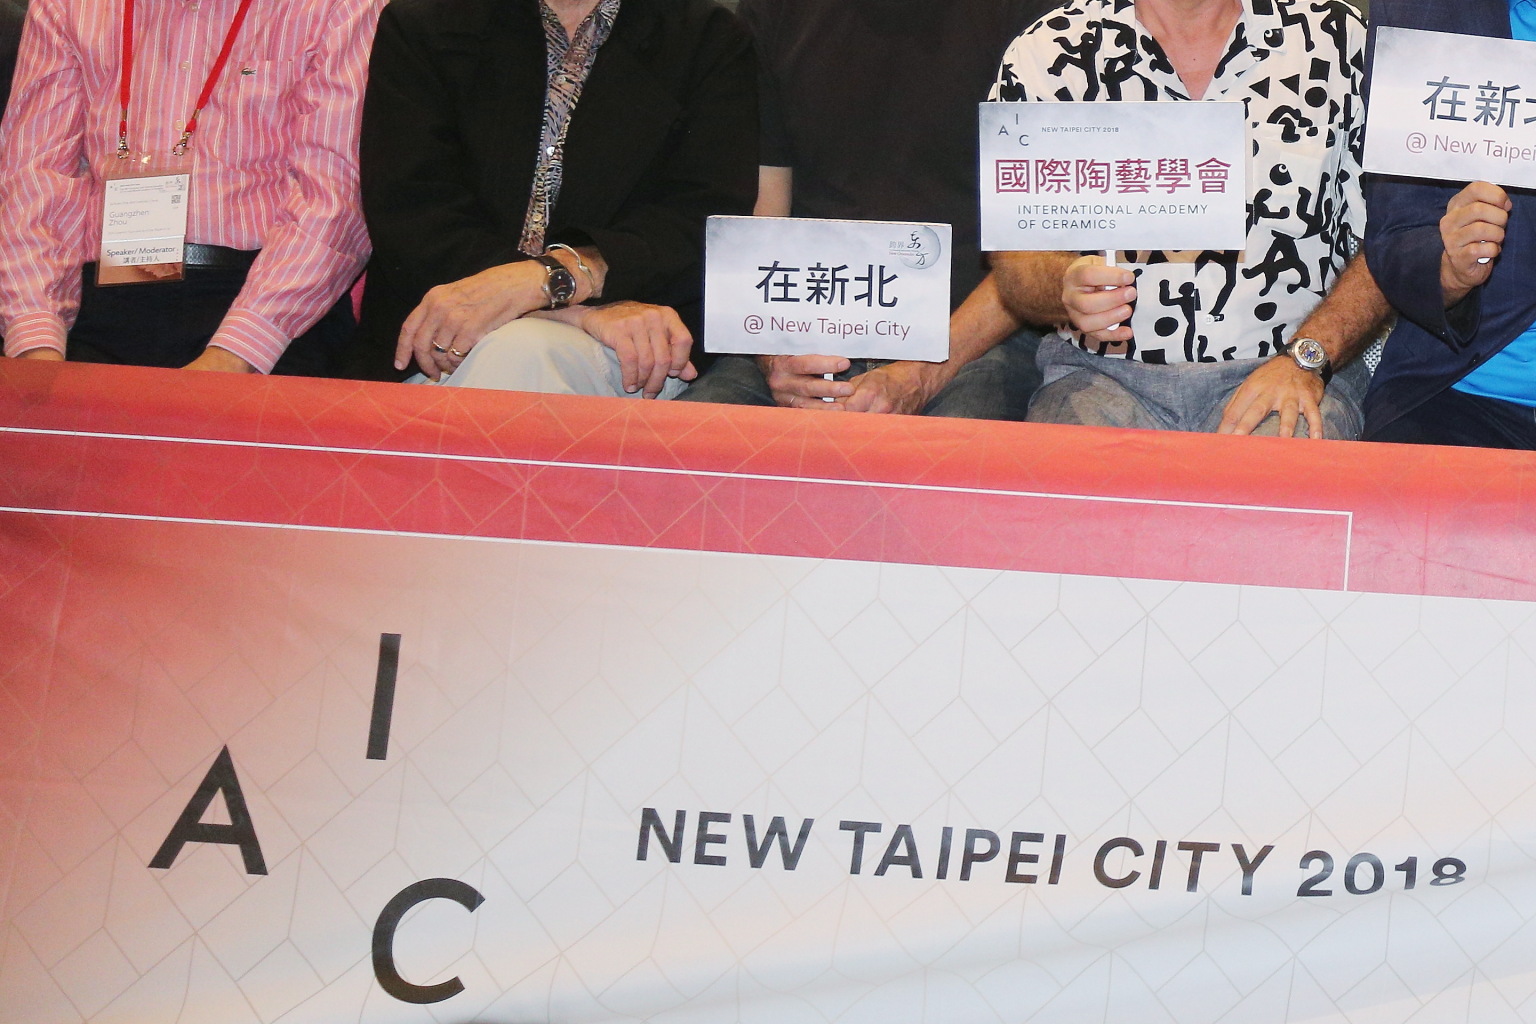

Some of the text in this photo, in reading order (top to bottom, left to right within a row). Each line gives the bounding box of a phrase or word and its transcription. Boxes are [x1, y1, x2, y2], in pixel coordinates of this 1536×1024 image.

[998, 125, 1009, 136] A
[1019, 135, 1029, 146] C
[1434, 135, 1477, 154] New
[1483, 140, 1536, 164] Taipei
[995, 157, 1232, 194] 國際陶藝學會
[1018, 204, 1208, 215] INTERNATIONAL ACADEMY
[1018, 220, 1116, 229] OF CERAMICS
[139, 246, 176, 254] Moderator
[756, 261, 898, 308] 在新北
[771, 317, 811, 333] New
[817, 318, 868, 339] Taipei
[875, 320, 910, 341] City
[366, 633, 401, 760] I
[148, 745, 269, 876] A
[636, 807, 1467, 897] NEW TAIPEI CITY 2018
[371, 877, 487, 1004] C
